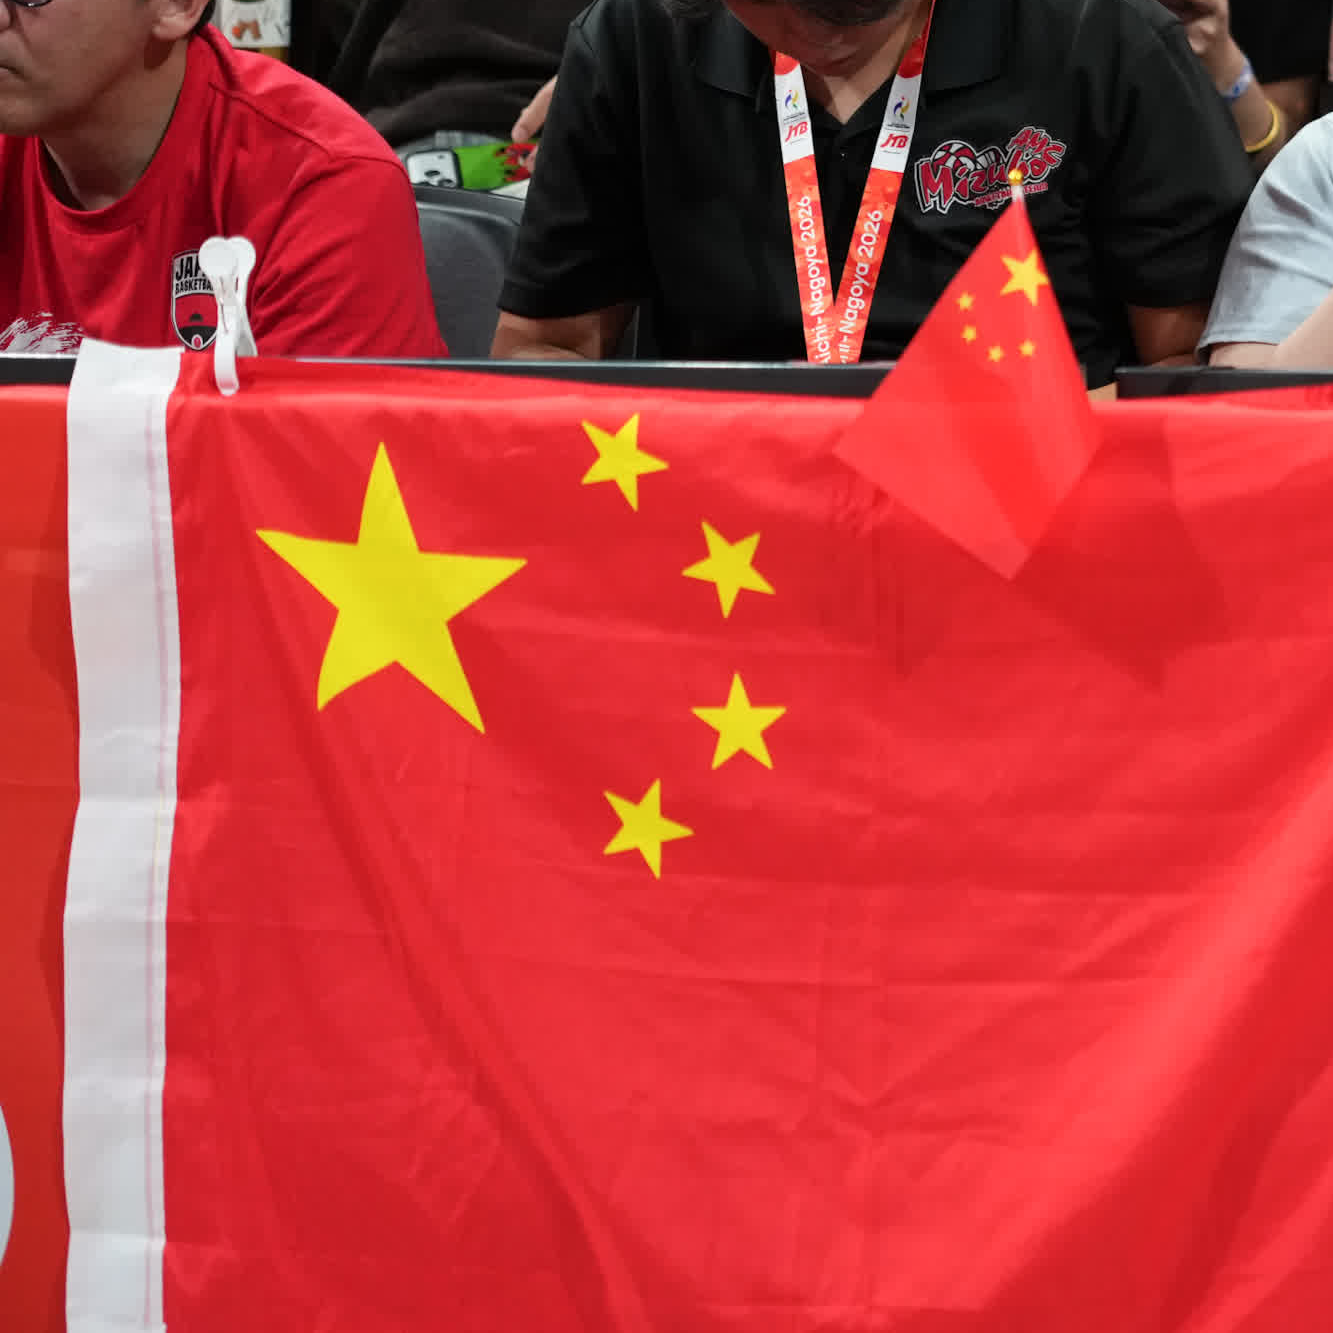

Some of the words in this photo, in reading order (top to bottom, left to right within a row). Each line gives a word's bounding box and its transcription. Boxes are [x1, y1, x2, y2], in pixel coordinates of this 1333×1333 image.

[784, 121, 808, 142] JTB
[881, 133, 908, 148] JTB
[797, 195, 816, 241] 2026
[858, 209, 883, 257] 2026
